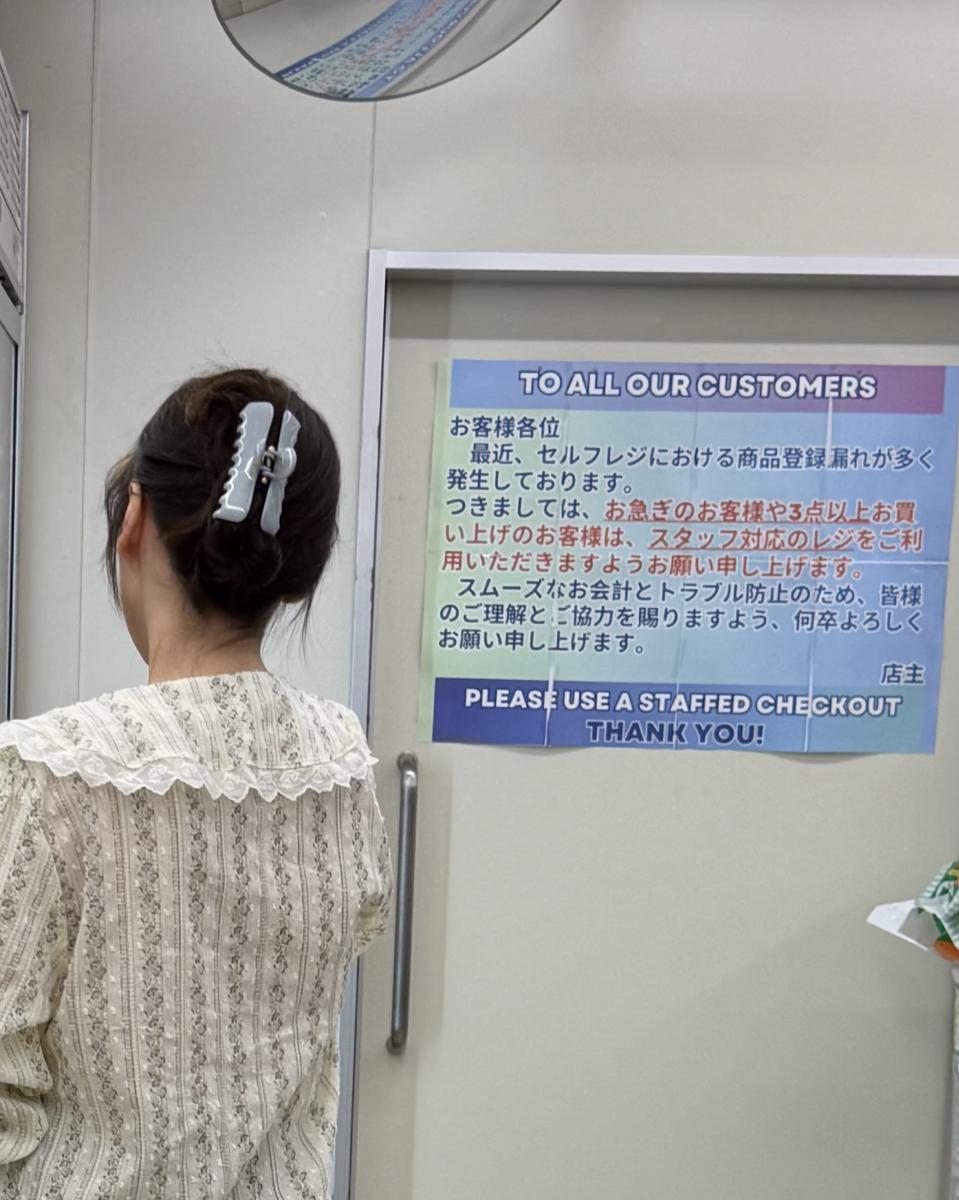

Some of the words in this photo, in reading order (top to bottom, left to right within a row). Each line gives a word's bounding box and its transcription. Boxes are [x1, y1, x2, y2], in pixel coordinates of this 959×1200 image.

[519, 371, 561, 395] TO
[567, 371, 620, 397] ALL
[626, 372, 691, 398] OUR
[696, 374, 877, 399] CUSTOMERS
[450, 416, 560, 438] お客様各位
[470, 443, 933, 470] 最近、セルフレジにおける商品登録漏れが多く
[447, 470, 632, 494] 発生しております。
[446, 496, 916, 524] つきましては、お急ぎのお客様や3点以上お買
[444, 523, 923, 551] い上げのお客様は、スタッフ対応のレジをご利
[442, 550, 862, 579] 用いただきますようお願い申し上げます。
[458, 578, 922, 607] スムーズなお会計とトラブル防止のため、皆様
[440, 603, 922, 633] のご理解とご協力を賜りますよう、何卒よろしく
[439, 628, 644, 654] お願い申し上げます。
[881, 664, 925, 684] 店主
[465, 688, 557, 710] PLEASE
[563, 689, 609, 711] USE
[615, 691, 633, 711] A
[639, 692, 750, 714] STAFFED
[756, 694, 901, 718] CHECKOUT
[587, 722, 685, 744] THANK
[695, 722, 765, 745] YOU!
